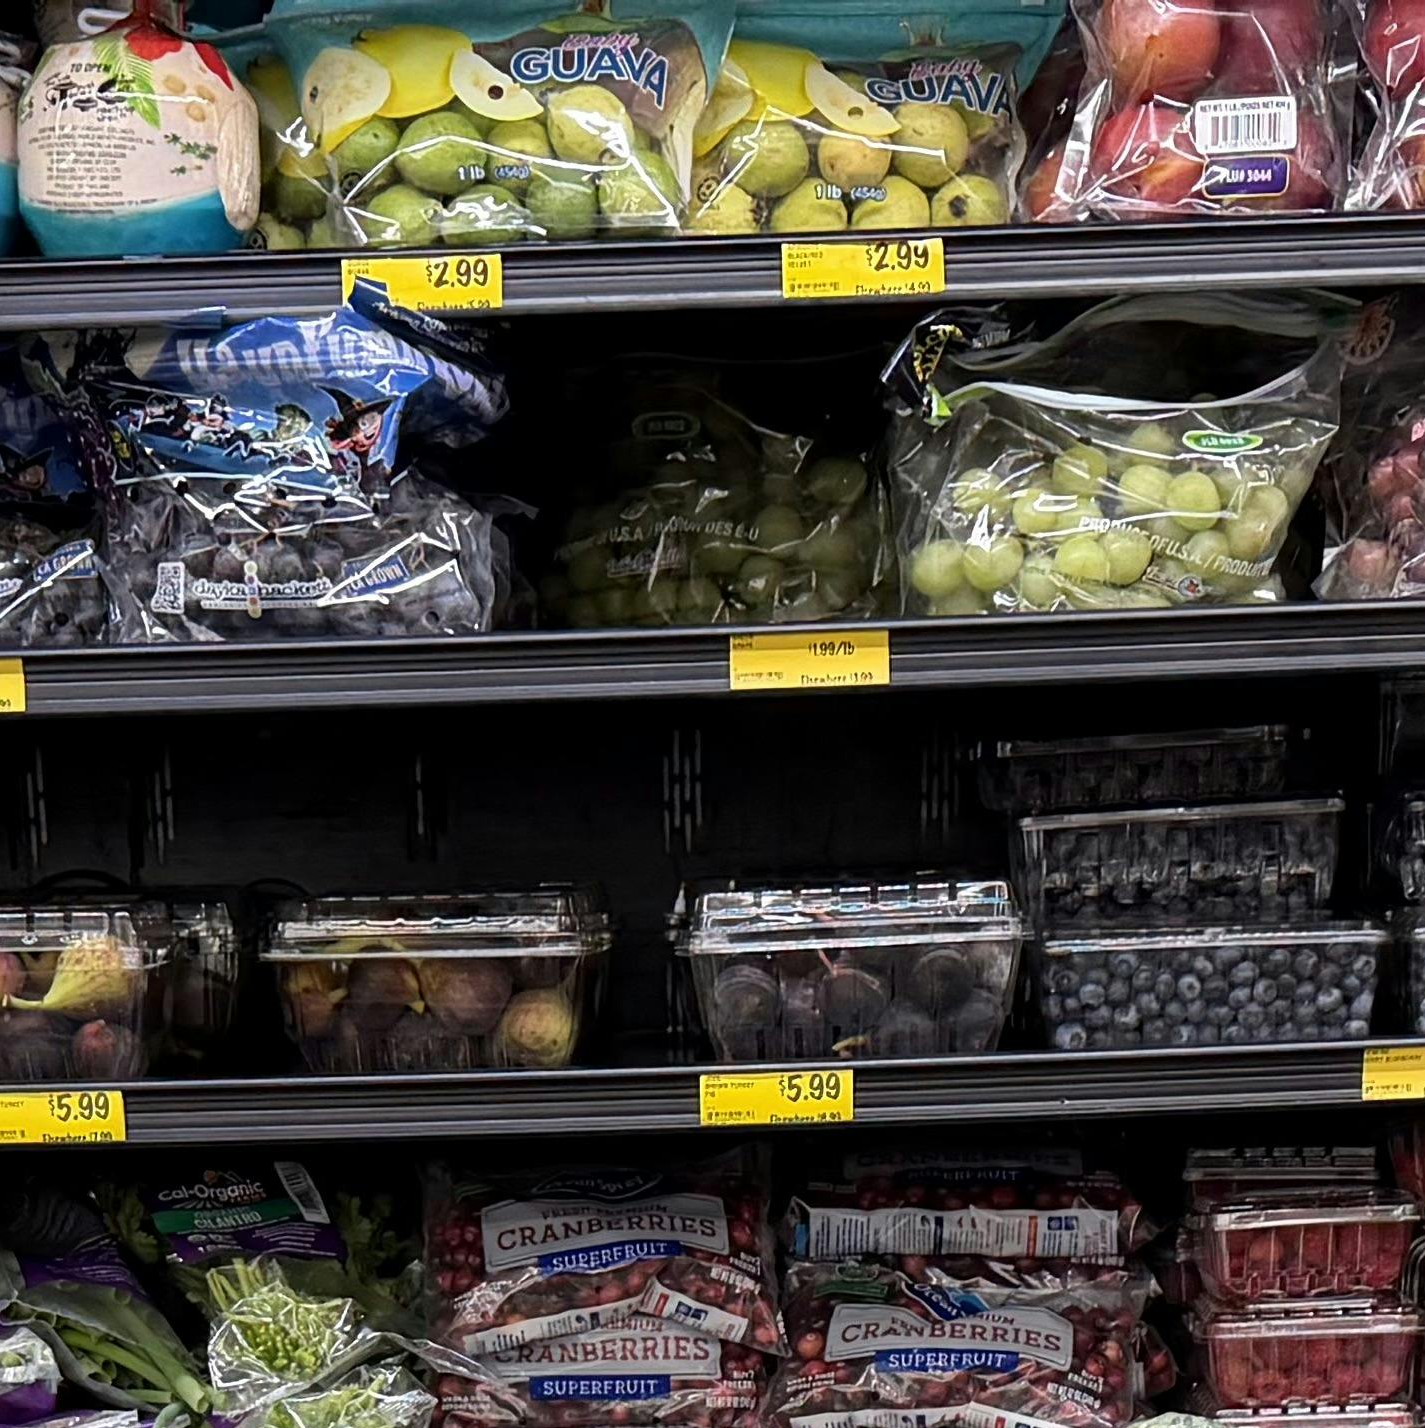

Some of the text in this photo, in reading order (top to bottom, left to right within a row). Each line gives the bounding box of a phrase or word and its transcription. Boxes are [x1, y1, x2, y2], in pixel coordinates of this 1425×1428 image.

[510, 47, 668, 109] GUAVA
[865, 73, 1013, 124] GUAVA
[471, 165, 486, 180] lb
[827, 184, 842, 199] lb
[865, 242, 930, 272] $2.99
[426, 258, 489, 289] $2.99
[807, 642, 856, 657] $1.99/lb
[778, 1073, 841, 1102] $5.99
[48, 1092, 110, 1123] $5.99
[194, 1211, 262, 1230] CILANTRO
[497, 1212, 716, 1251] CRANBERRIES
[551, 1241, 667, 1273] SUPERFRUIT
[494, 1336, 710, 1365] CRANBERRIES
[841, 1320, 1062, 1352] CRANBERRIES
[887, 1352, 1006, 1370] SUPERFRUIT
[542, 1378, 659, 1397] SUPERFRUIT
